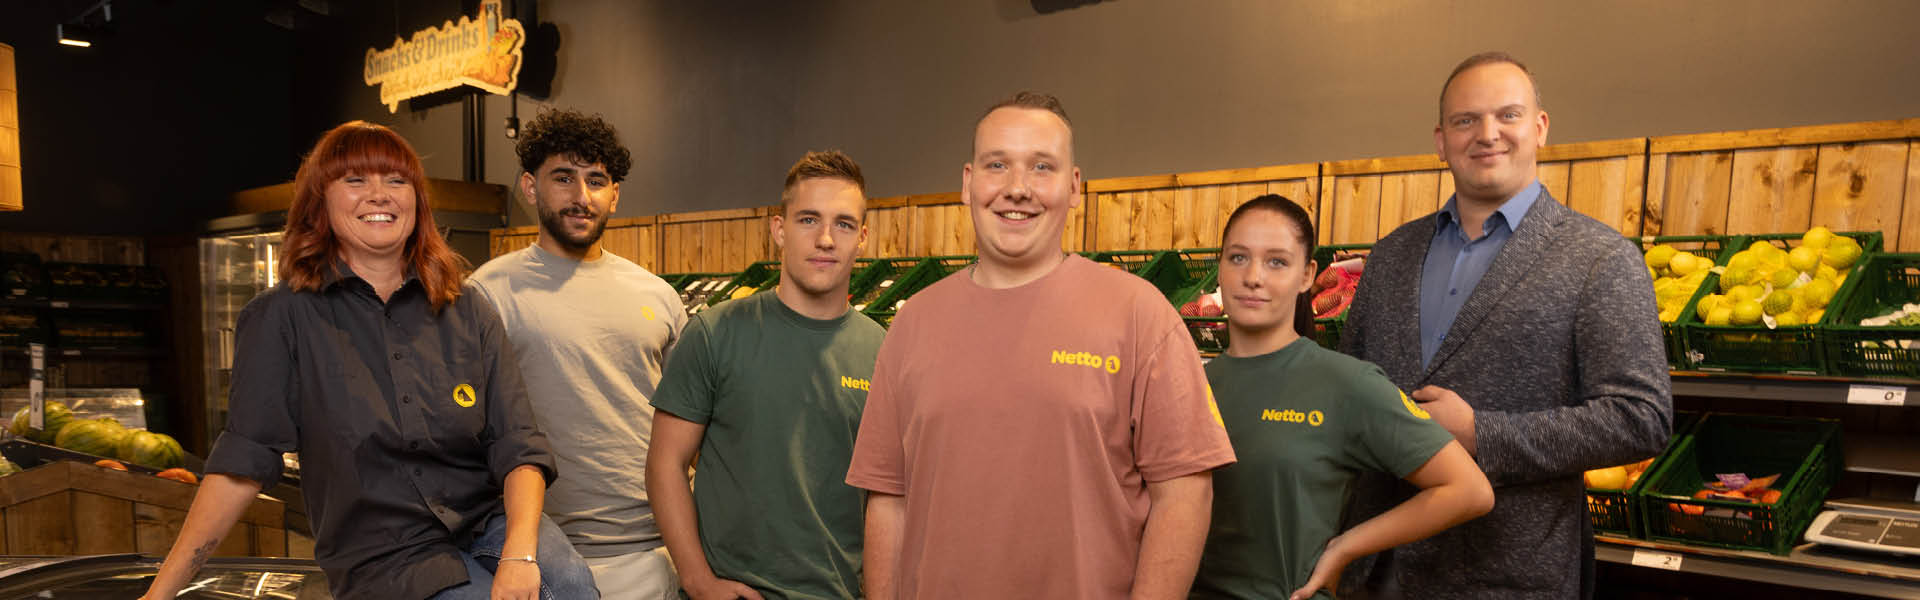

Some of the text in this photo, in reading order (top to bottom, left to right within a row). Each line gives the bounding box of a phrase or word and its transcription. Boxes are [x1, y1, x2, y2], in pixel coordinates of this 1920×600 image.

[1051, 350, 1103, 369] Netto
[841, 375, 871, 391] Nett
[1262, 408, 1306, 423] Netto
